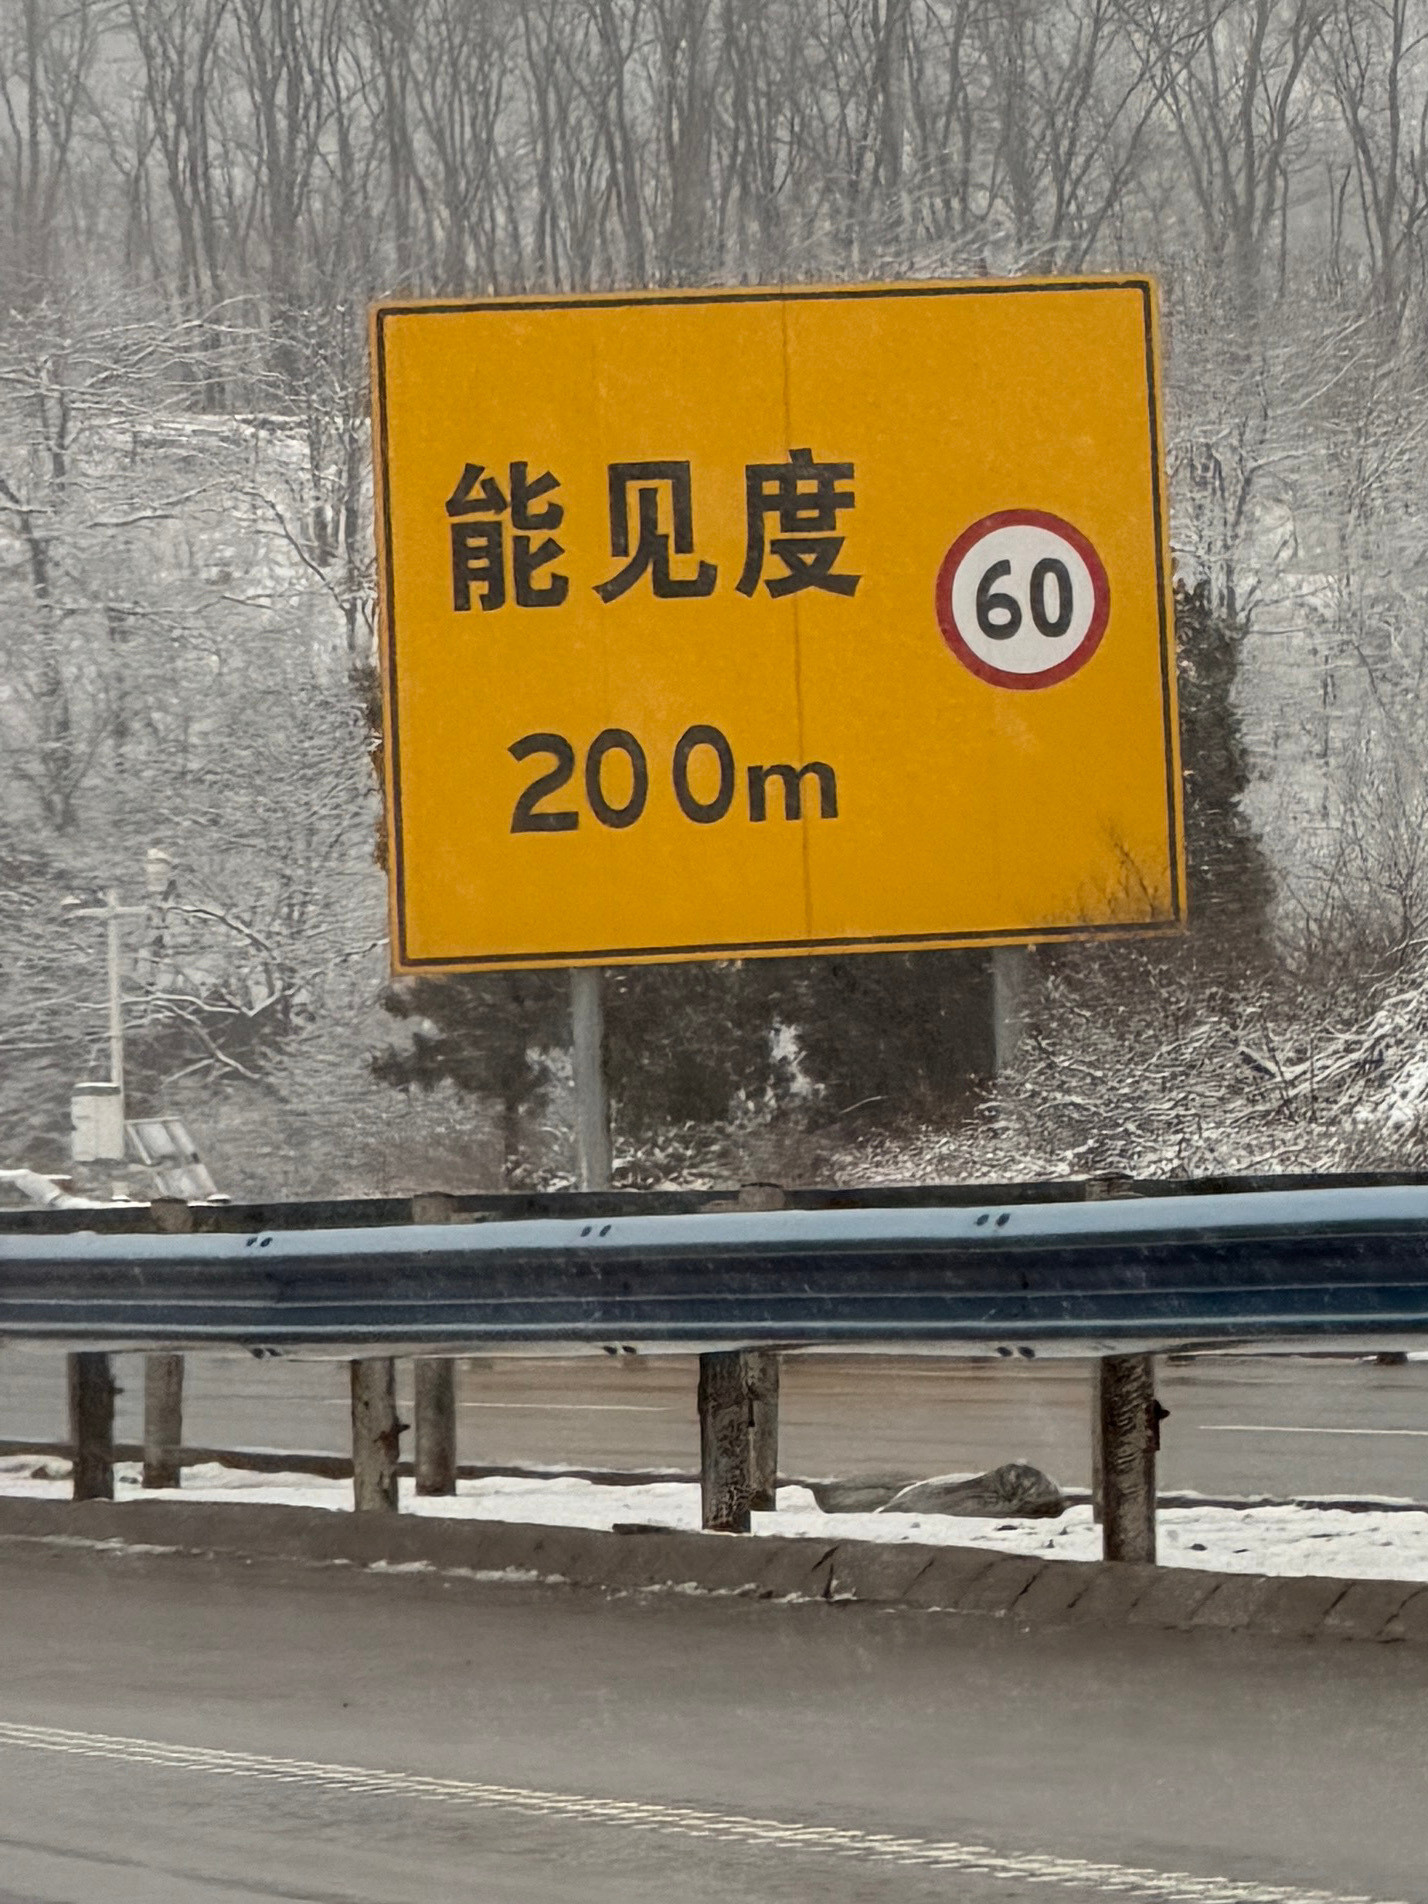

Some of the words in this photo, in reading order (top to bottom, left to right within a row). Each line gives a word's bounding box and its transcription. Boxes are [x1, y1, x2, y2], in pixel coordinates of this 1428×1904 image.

[446, 448, 860, 611] 能见度
[976, 558, 1073, 640] 60
[508, 725, 838, 833] 200m
